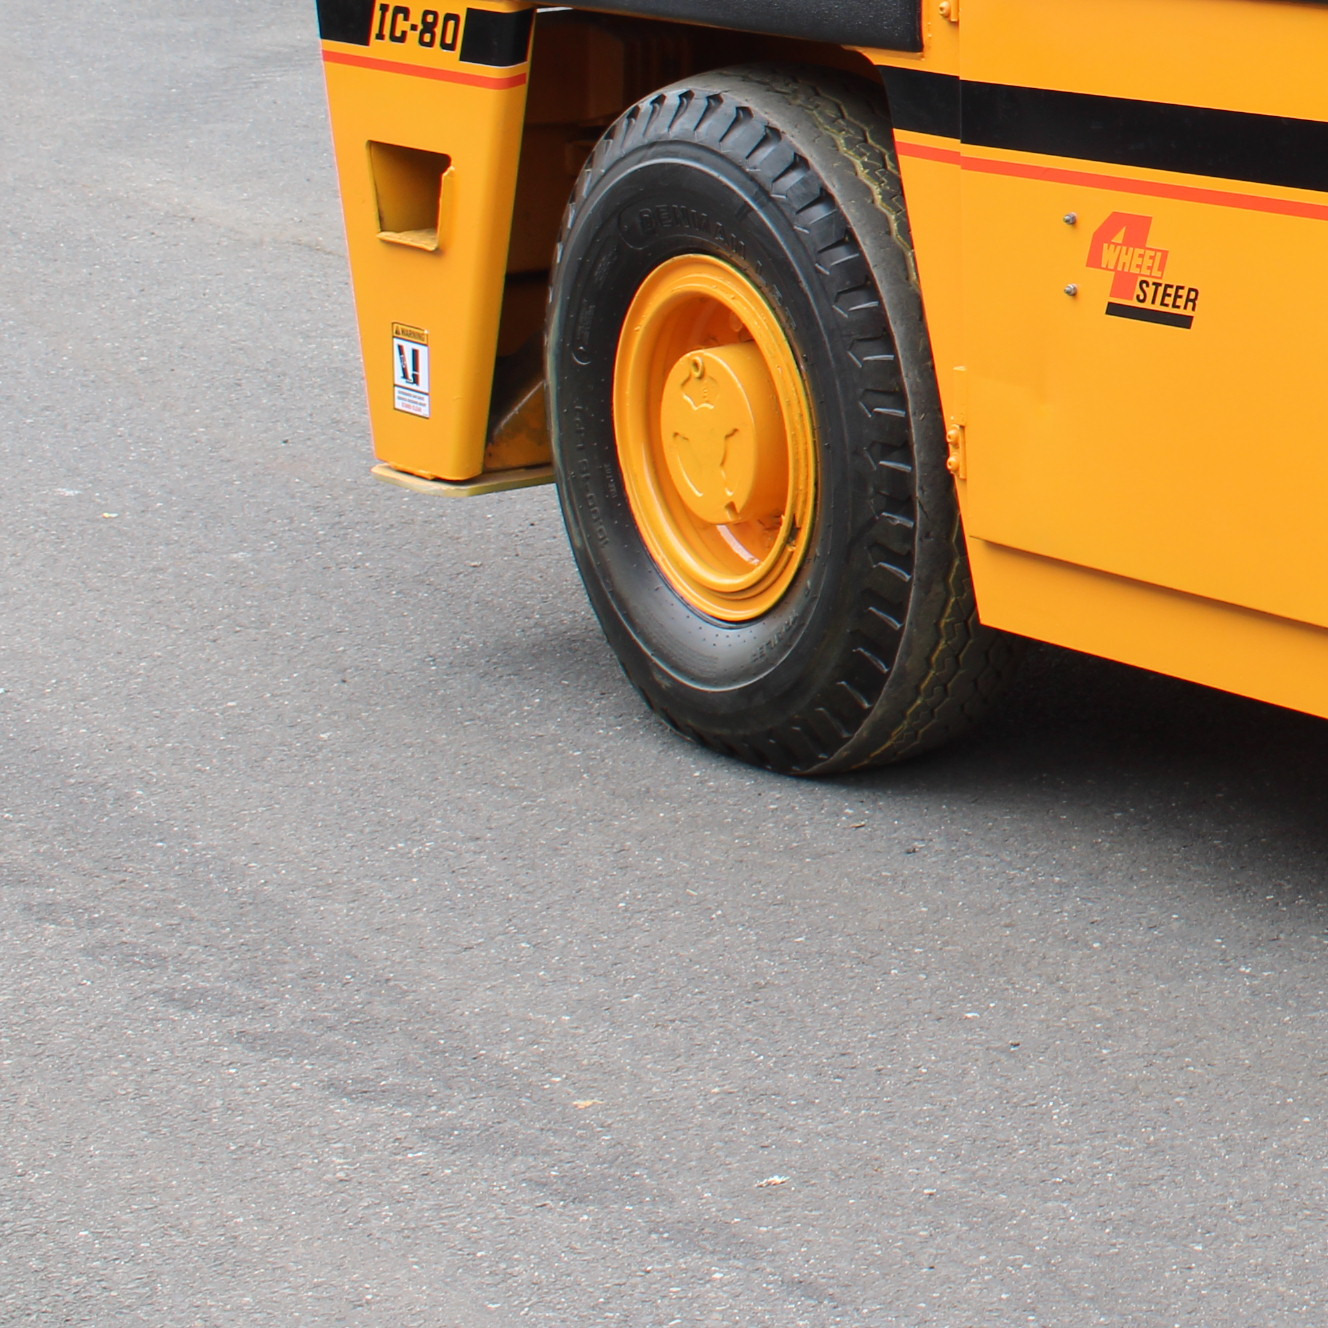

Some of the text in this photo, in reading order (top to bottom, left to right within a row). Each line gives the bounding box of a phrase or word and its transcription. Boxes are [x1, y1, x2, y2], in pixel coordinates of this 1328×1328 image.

[375, 3, 461, 52] IC-80
[1101, 243, 1162, 278] WHEEL
[1136, 279, 1199, 312] STEER
